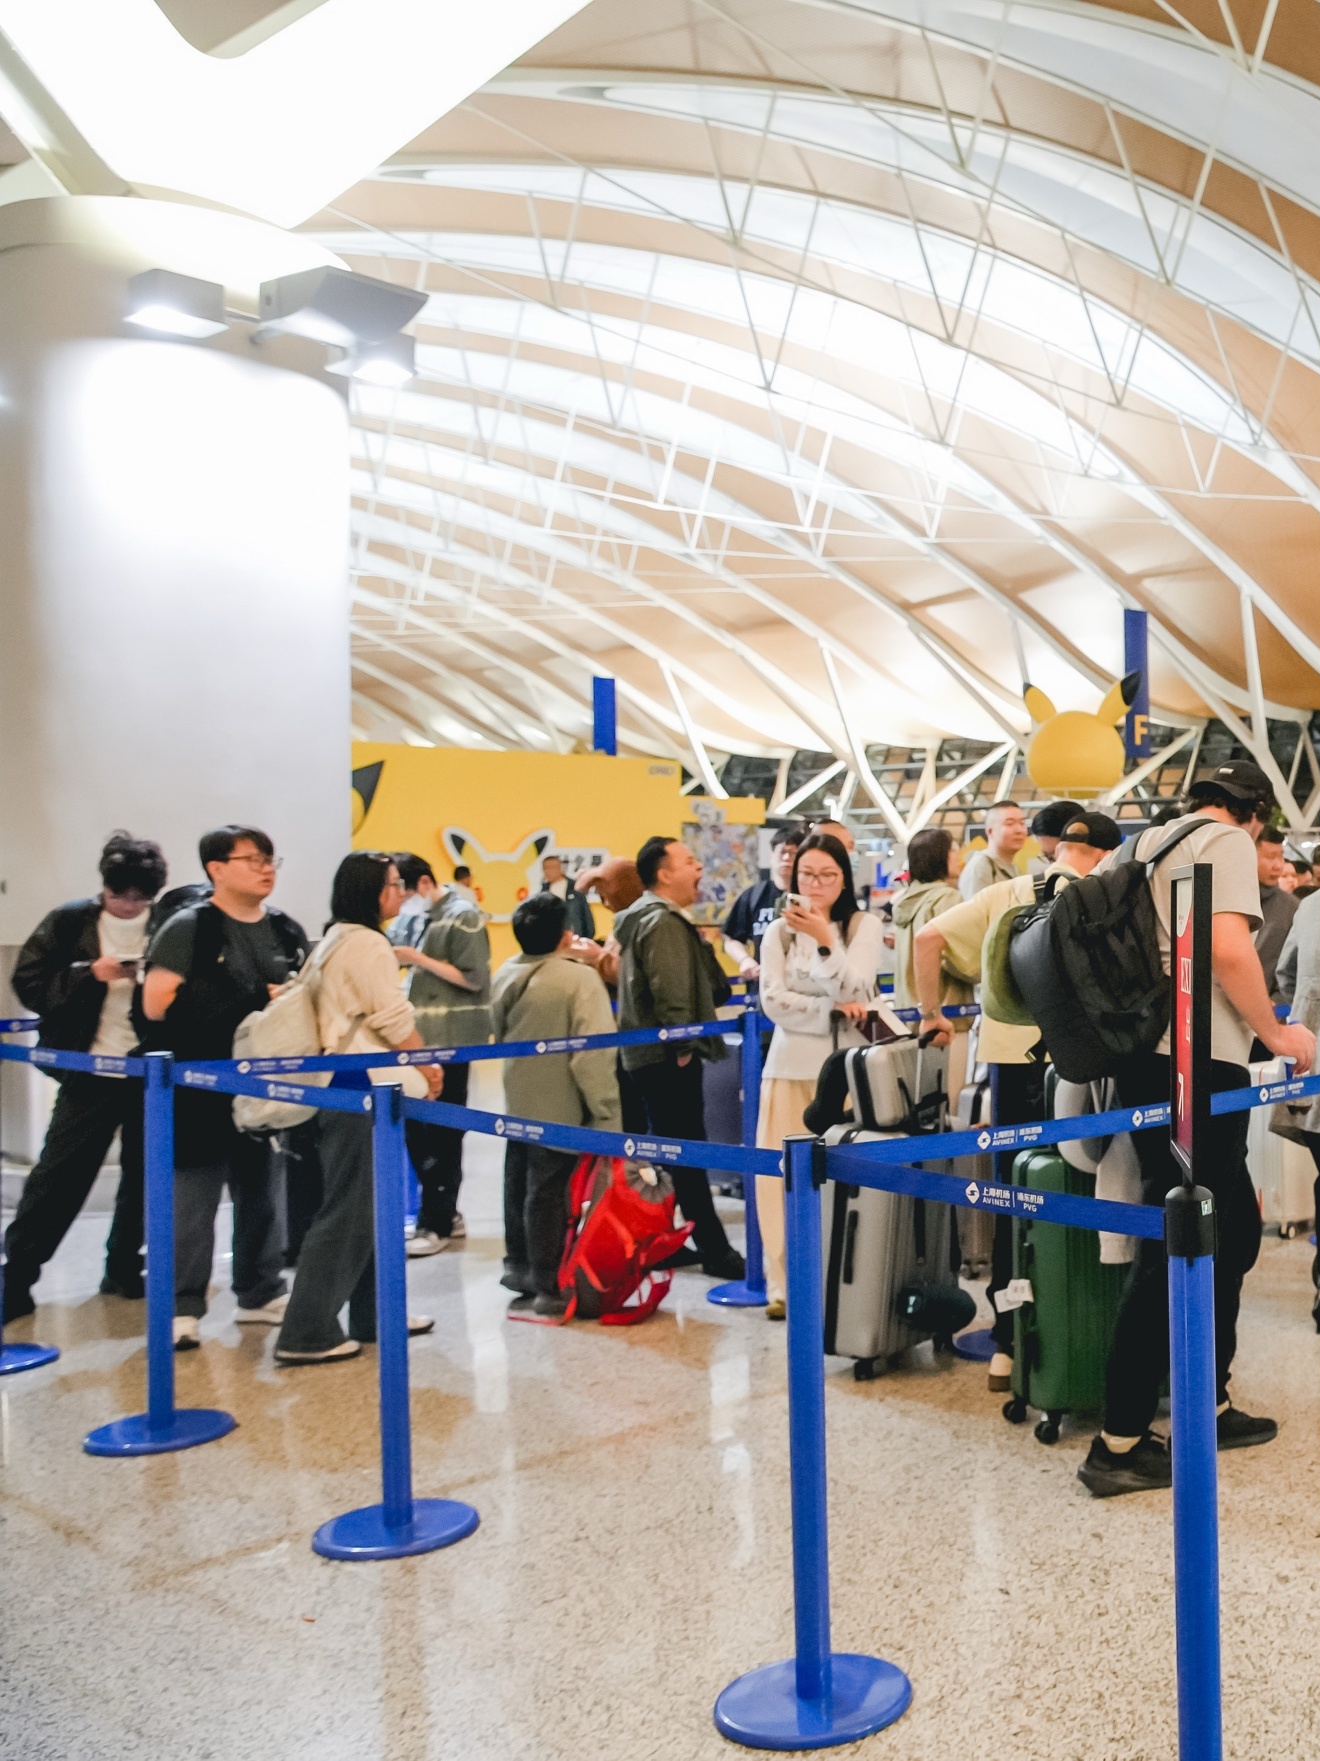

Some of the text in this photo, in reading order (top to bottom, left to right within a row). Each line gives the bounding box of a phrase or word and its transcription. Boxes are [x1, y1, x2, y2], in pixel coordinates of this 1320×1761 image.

[1134, 714, 1149, 746] F
[982, 1196, 1037, 1212] AVINEX PVG
